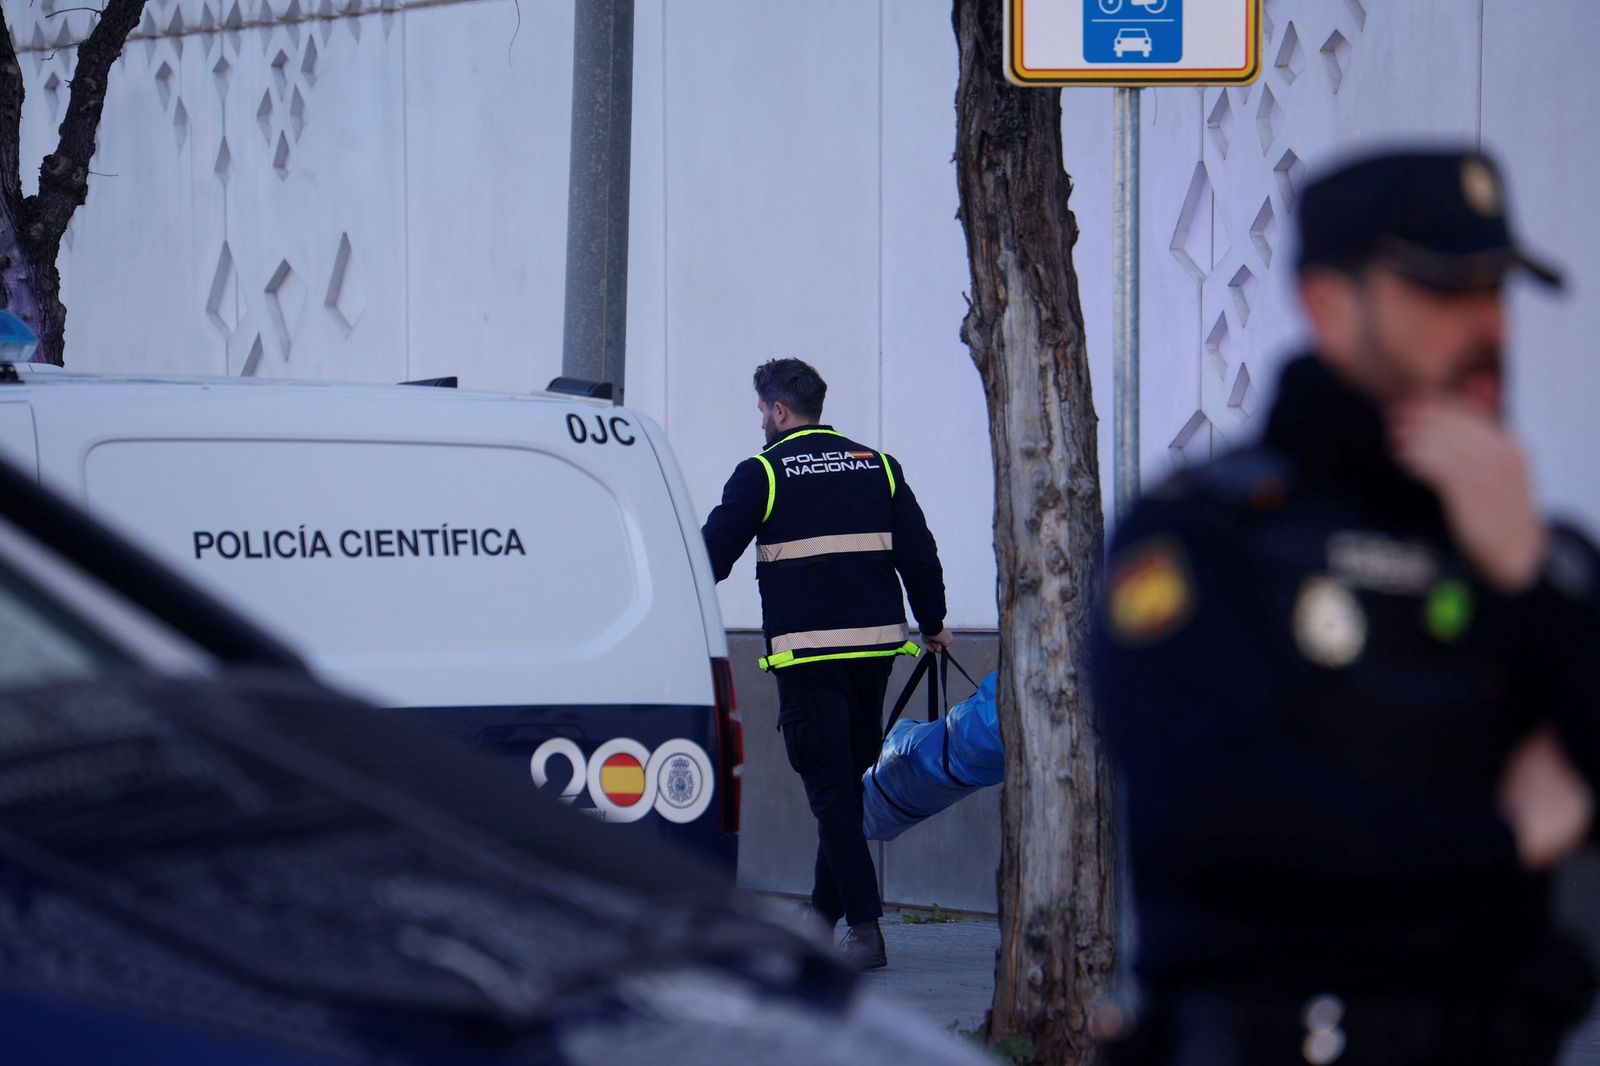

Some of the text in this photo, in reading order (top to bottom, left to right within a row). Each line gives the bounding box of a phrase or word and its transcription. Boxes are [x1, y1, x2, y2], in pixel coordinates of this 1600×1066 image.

[785, 460, 880, 478] NACIONAL
[193, 524, 526, 559] POLICÍA CIENTÍFICA
